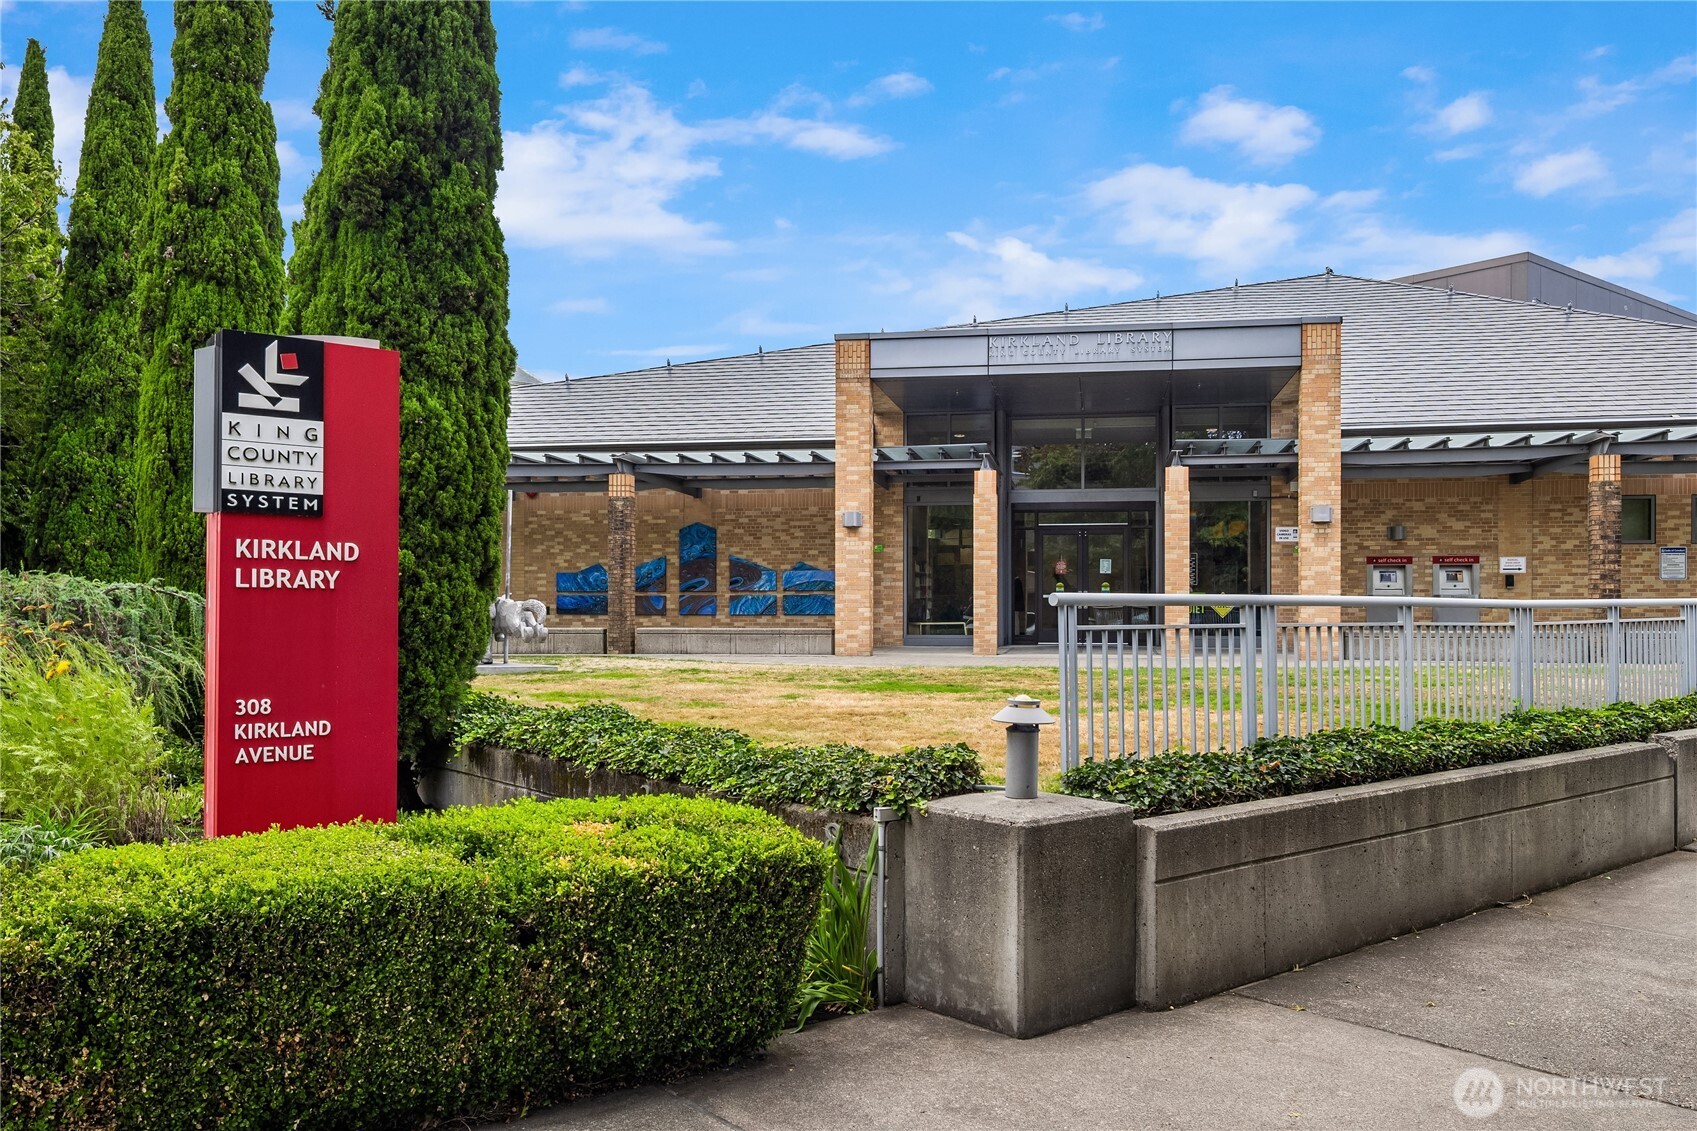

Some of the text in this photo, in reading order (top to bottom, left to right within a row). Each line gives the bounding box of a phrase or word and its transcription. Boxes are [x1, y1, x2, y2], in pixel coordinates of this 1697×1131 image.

[989, 331, 1172, 349] KIRKLAND LIBRARY
[1023, 348, 1066, 357] COUNTY
[1130, 345, 1172, 354] SYSTEM
[228, 420, 319, 442] KING
[227, 445, 318, 467] COUNTY
[228, 471, 318, 490] LIBRARY
[227, 493, 319, 511] SYSTEM
[235, 538, 360, 562] KIRKLAND
[235, 568, 340, 590] LIBRARY
[235, 698, 272, 716] 308
[234, 720, 332, 740] KIRKLAND
[235, 744, 315, 764] AVENUE
